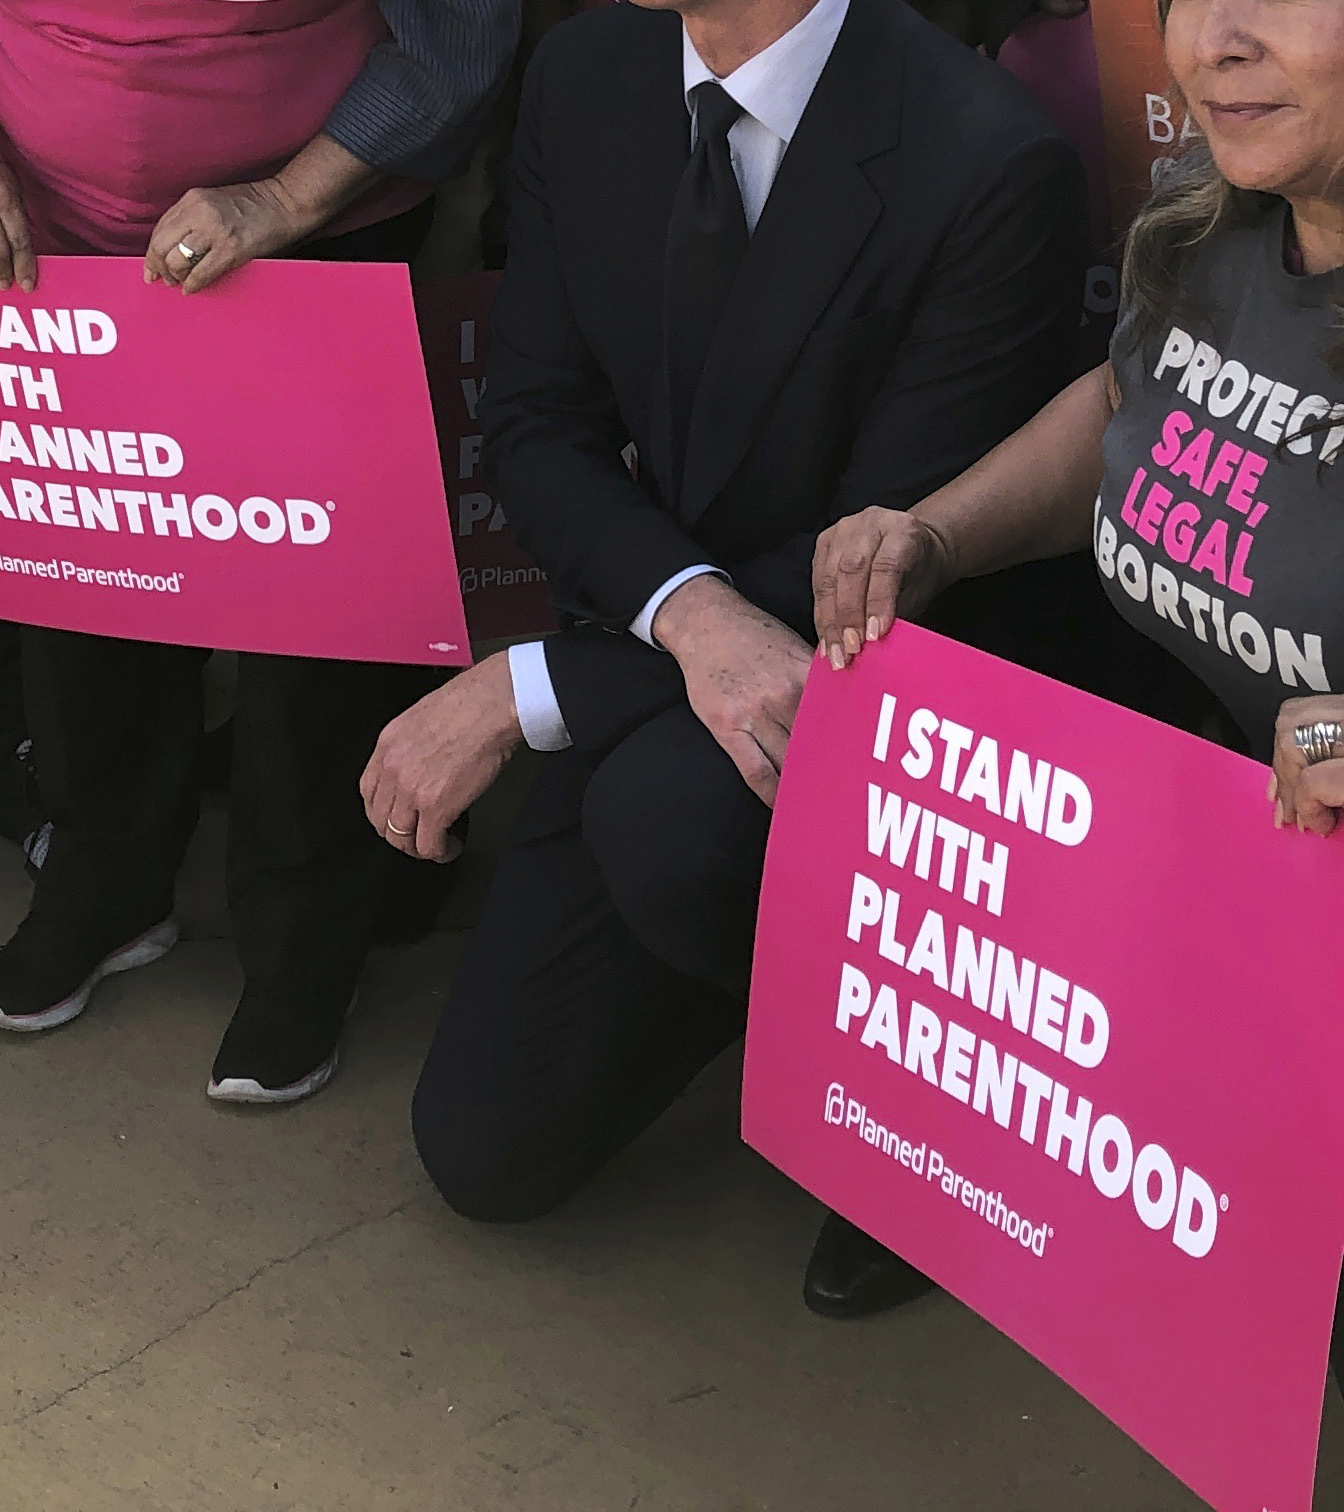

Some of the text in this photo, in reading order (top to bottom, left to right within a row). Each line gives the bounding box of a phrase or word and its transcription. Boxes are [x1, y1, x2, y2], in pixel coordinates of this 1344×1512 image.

[1120, 467, 1255, 598] LEGAL
[1151, 409, 1270, 528] SAFE,
[61, 560, 182, 594] Parenthood
[482, 566, 548, 588] Plann
[1093, 494, 1332, 692] BORTION
[872, 692, 1093, 846] I STAND
[867, 782, 1010, 917] WITH
[846, 871, 1110, 1069] PLANNED
[834, 961, 1219, 1259] PARENTHOOD
[846, 1097, 1047, 1258] Planned Parenthood
